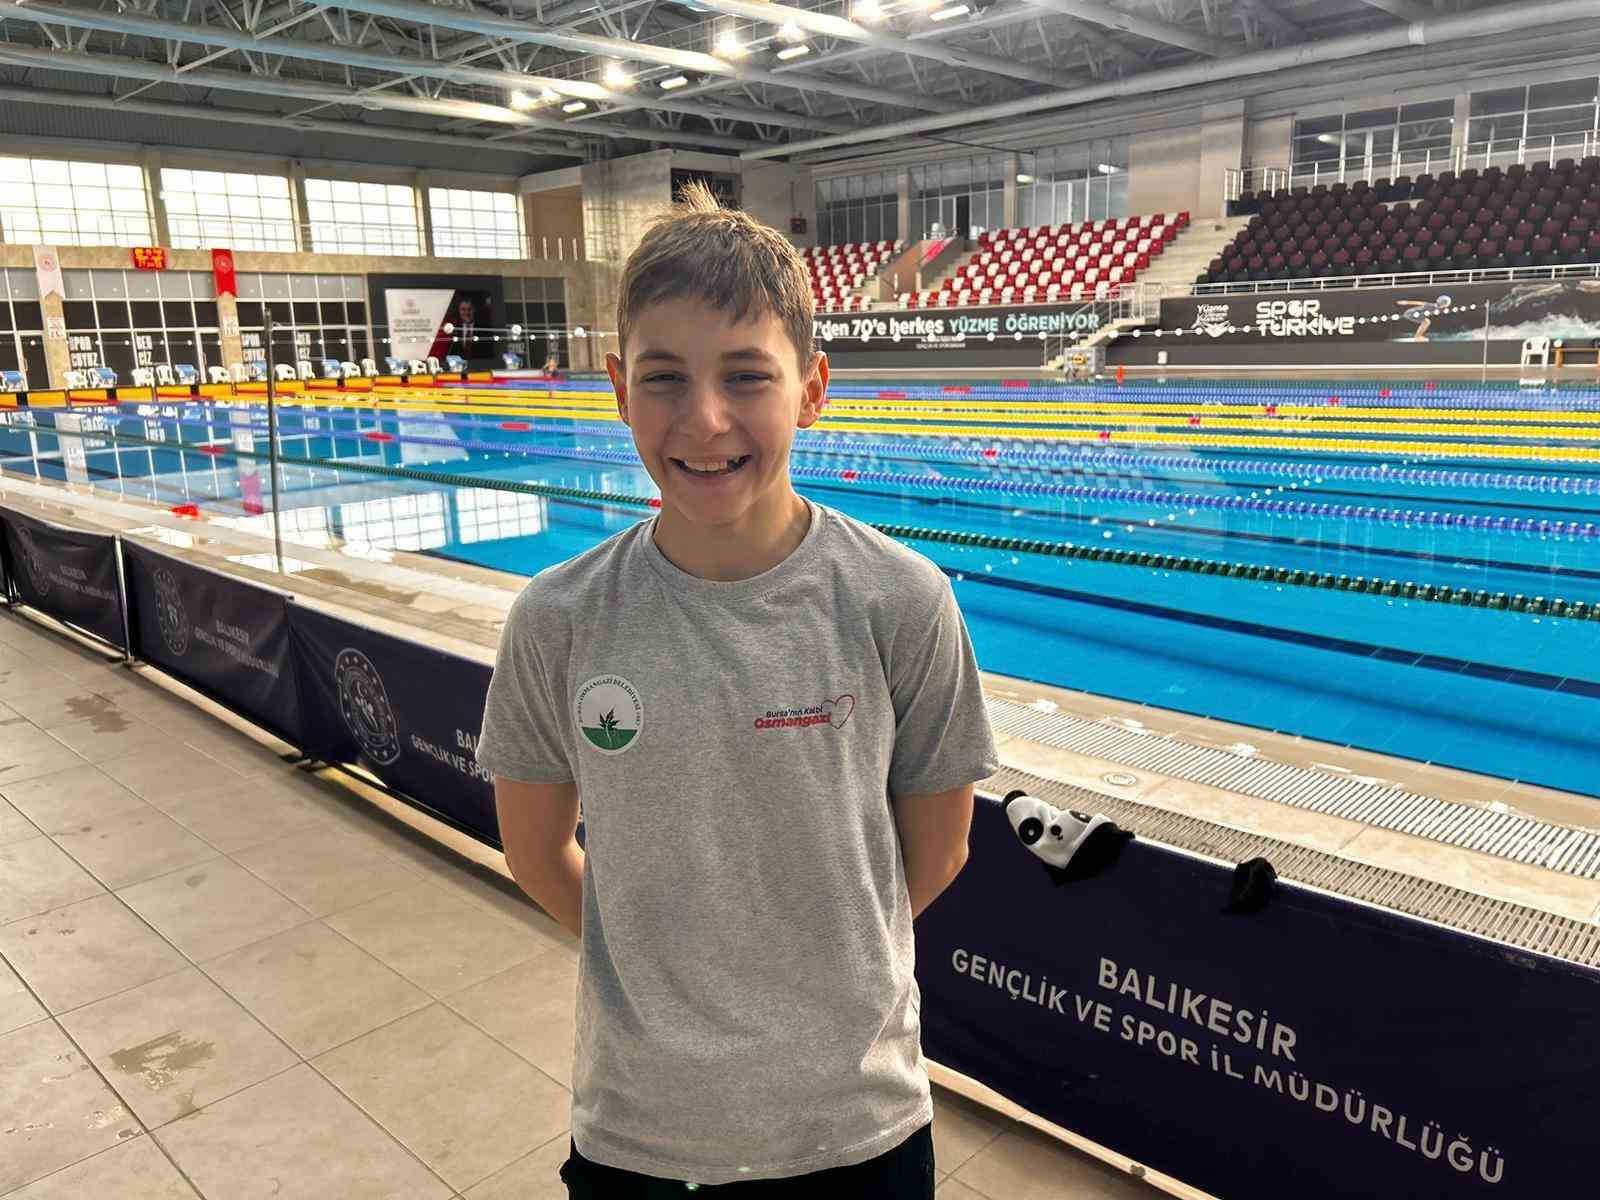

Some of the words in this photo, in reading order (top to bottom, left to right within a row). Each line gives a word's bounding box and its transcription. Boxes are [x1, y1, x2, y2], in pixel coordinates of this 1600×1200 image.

[1256, 300, 1320, 319] SPOR
[851, 318, 887, 336] 70'e
[889, 316, 944, 335] herkes
[950, 316, 999, 333] YÜZME
[1006, 312, 1099, 332] ÖĞRENİYOR
[1256, 314, 1355, 336] TÜRKİYE
[754, 712, 832, 728] Osmangazi
[451, 753, 467, 774] VE
[1098, 957, 1298, 1062] BALIKESİR
[951, 948, 1067, 1013] GENÇLİK
[1074, 994, 1113, 1031] VE
[1120, 1014, 1201, 1066] SPOR
[1211, 1043, 1244, 1080] İL
[1253, 1064, 1506, 1185] MÜDÜRLÜĞÜ
